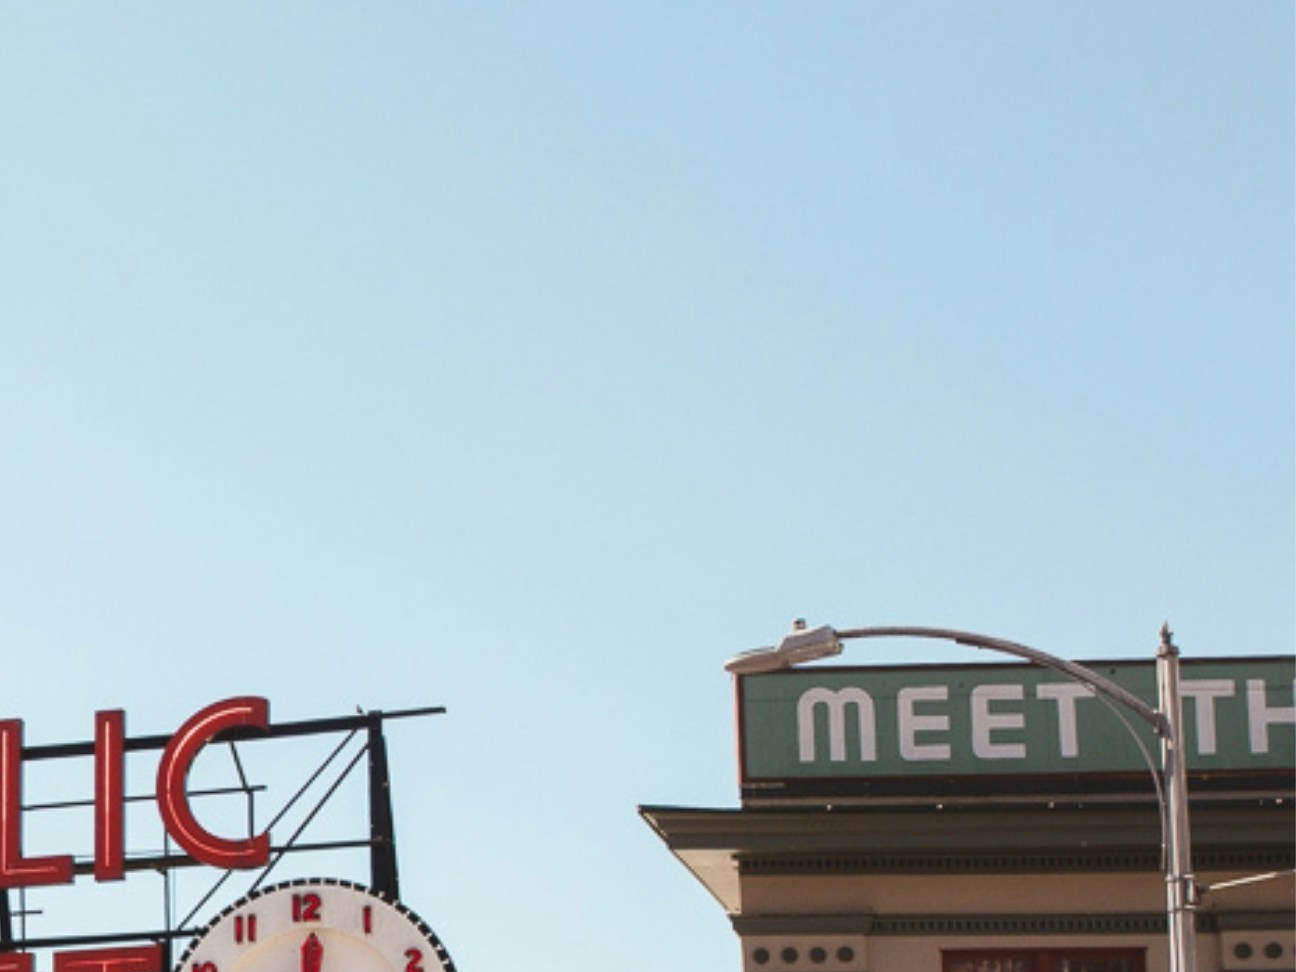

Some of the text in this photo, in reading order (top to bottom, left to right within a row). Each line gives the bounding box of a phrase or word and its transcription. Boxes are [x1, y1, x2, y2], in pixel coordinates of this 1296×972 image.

[797, 680, 1296, 762] MEET TH
[292, 894, 321, 922] 12
[362, 905, 372, 934] 1
[234, 914, 257, 944] 11
